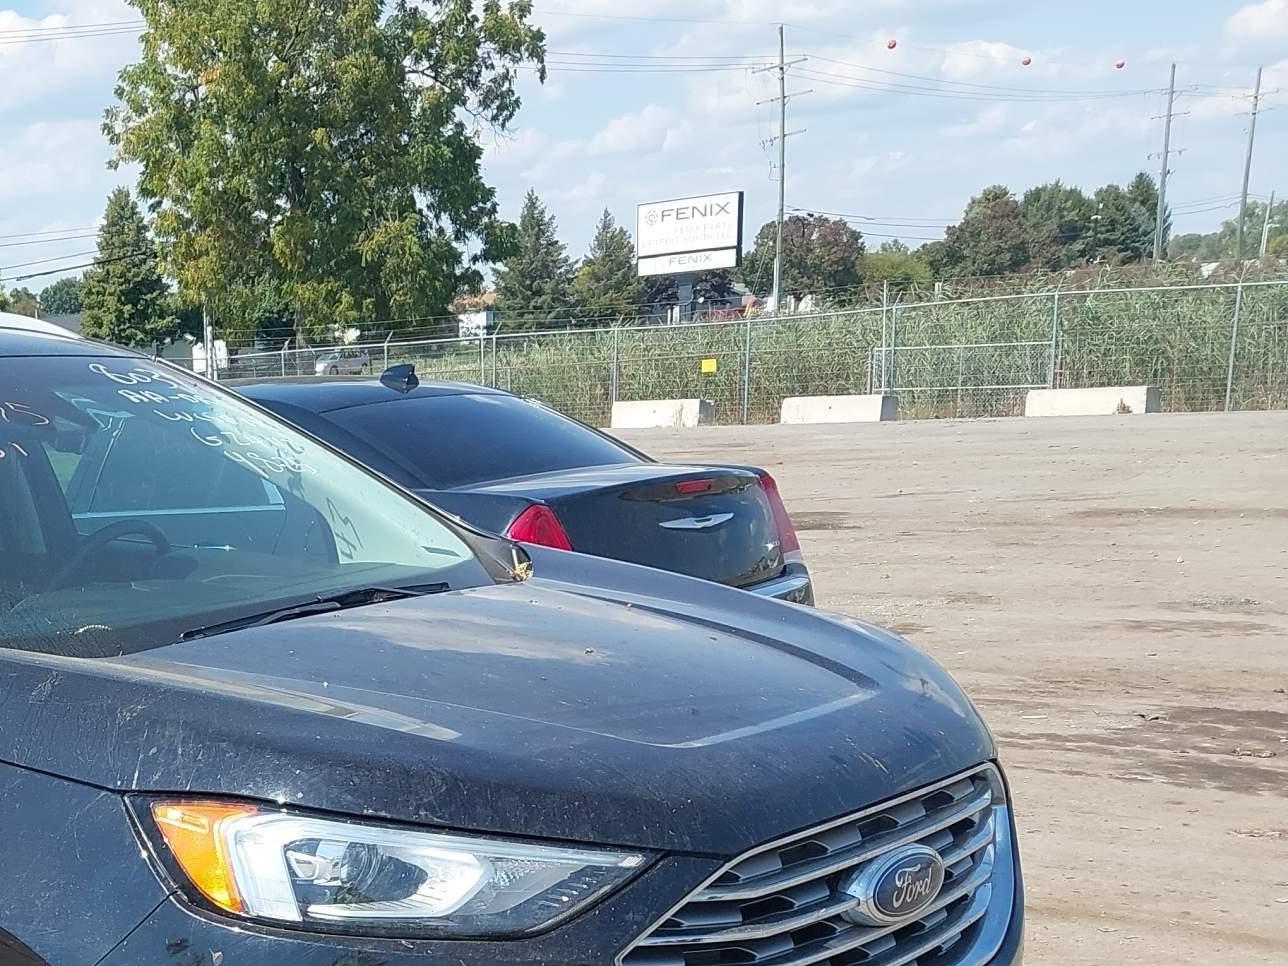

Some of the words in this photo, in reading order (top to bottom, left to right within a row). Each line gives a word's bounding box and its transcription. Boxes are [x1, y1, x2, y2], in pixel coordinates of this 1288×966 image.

[660, 201, 731, 223] FENIX
[668, 253, 713, 266] FENIX
[892, 863, 933, 909] Ford
